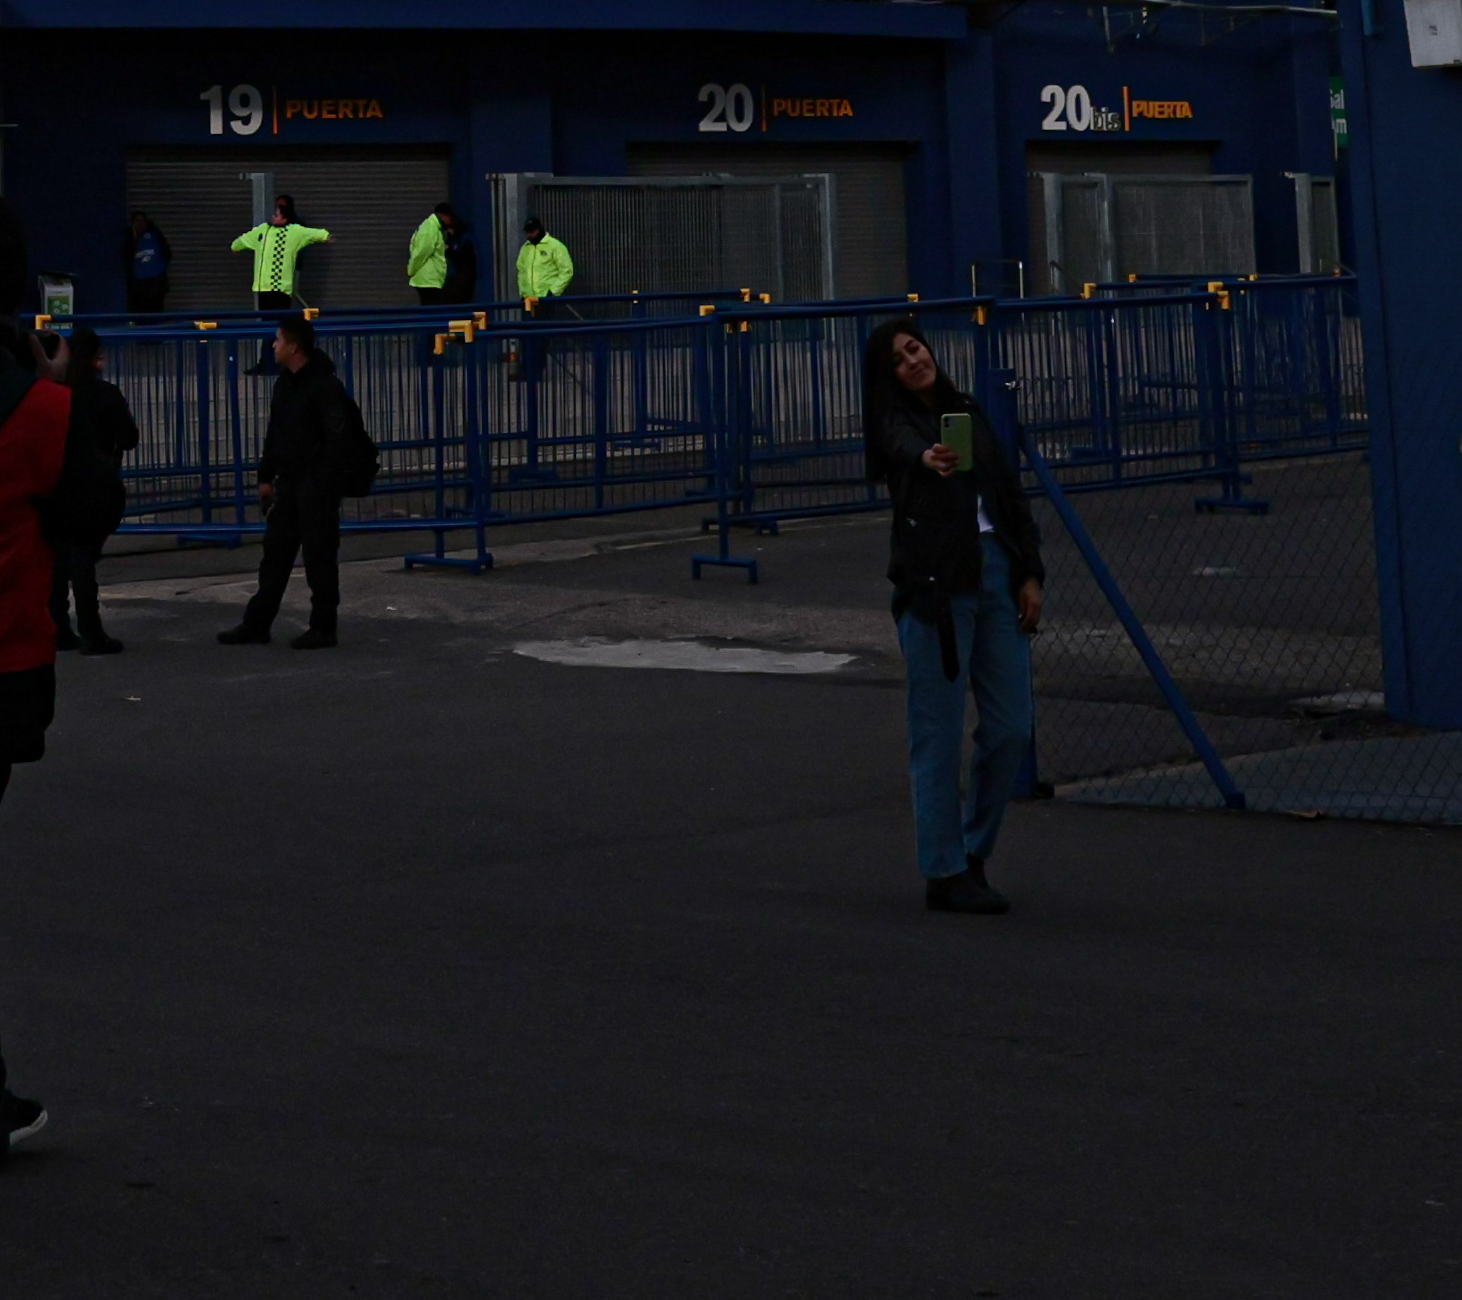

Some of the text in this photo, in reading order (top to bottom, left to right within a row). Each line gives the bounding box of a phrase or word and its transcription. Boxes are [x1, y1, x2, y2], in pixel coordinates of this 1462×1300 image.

[199, 83, 385, 136] 19 PUERTA
[697, 82, 855, 133] 20 PUERTA
[1131, 100, 1194, 119] PUERTA
